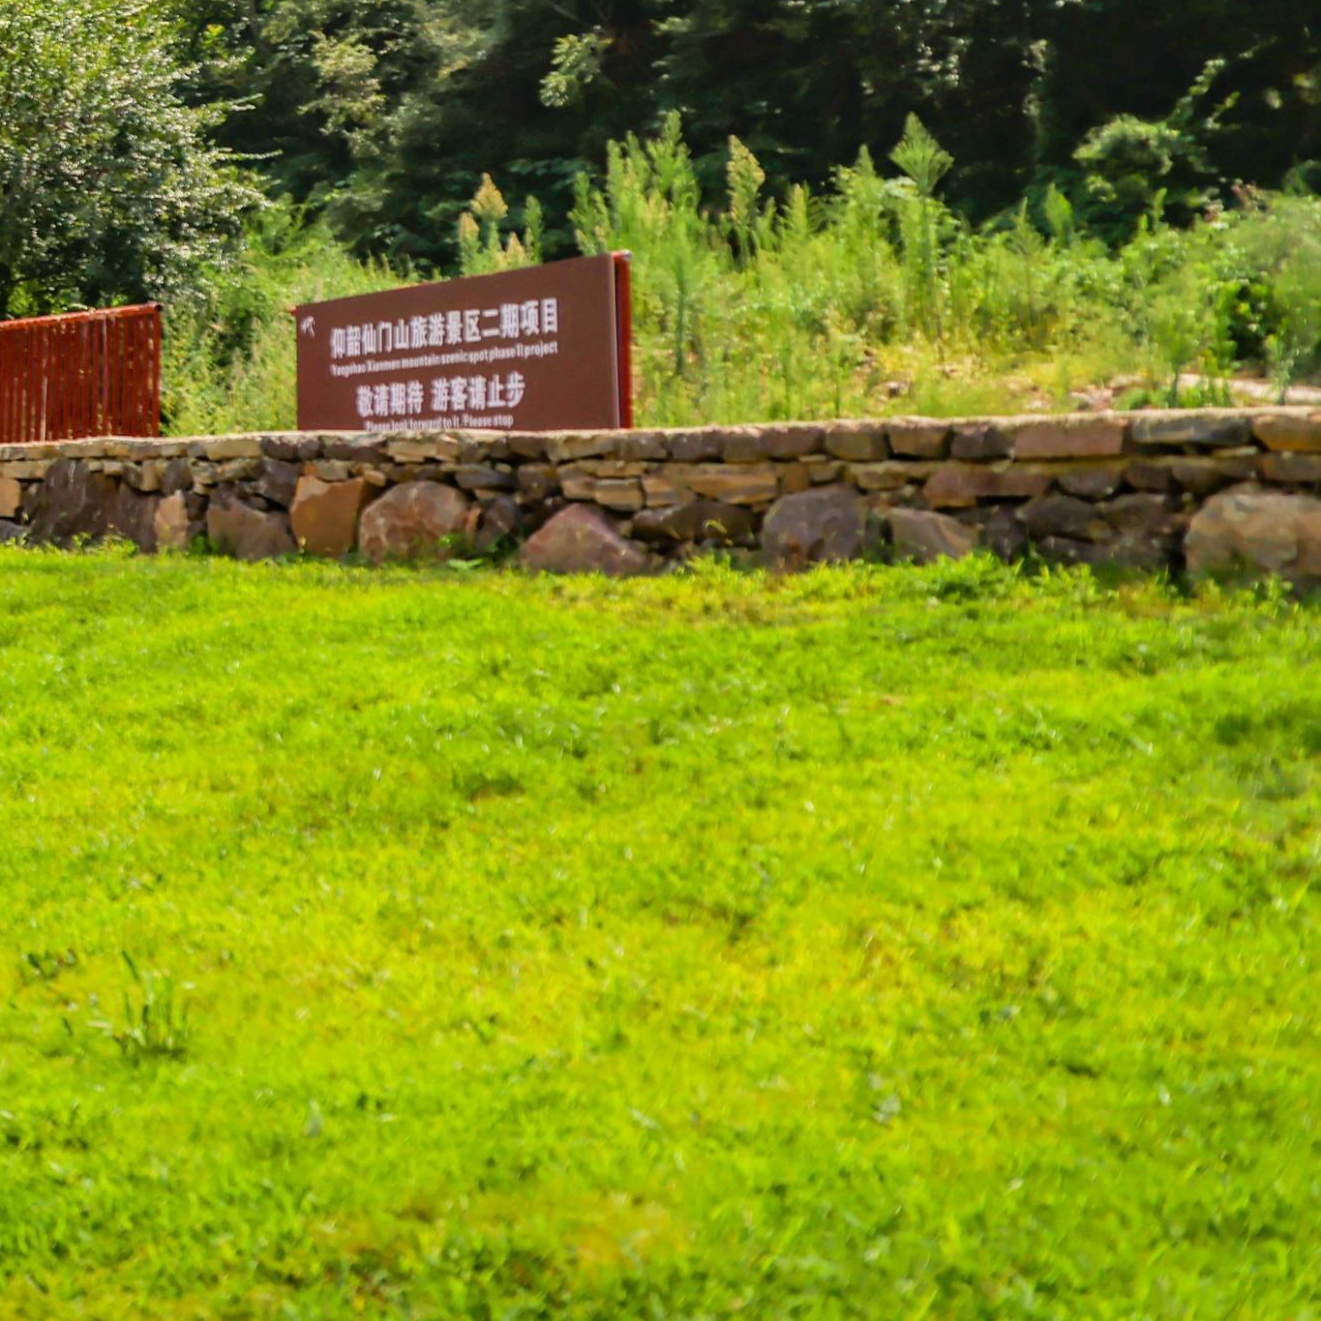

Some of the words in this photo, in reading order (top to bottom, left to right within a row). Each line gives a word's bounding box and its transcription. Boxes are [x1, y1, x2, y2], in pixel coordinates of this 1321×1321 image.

[401, 353, 440, 369] mountain
[442, 350, 468, 365] scenic
[469, 349, 488, 364] spot
[489, 346, 515, 363] phase
[524, 341, 557, 359] project
[357, 380, 423, 417] 敬请期待
[431, 370, 525, 411] 游客请止步
[494, 413, 514, 428] stop
